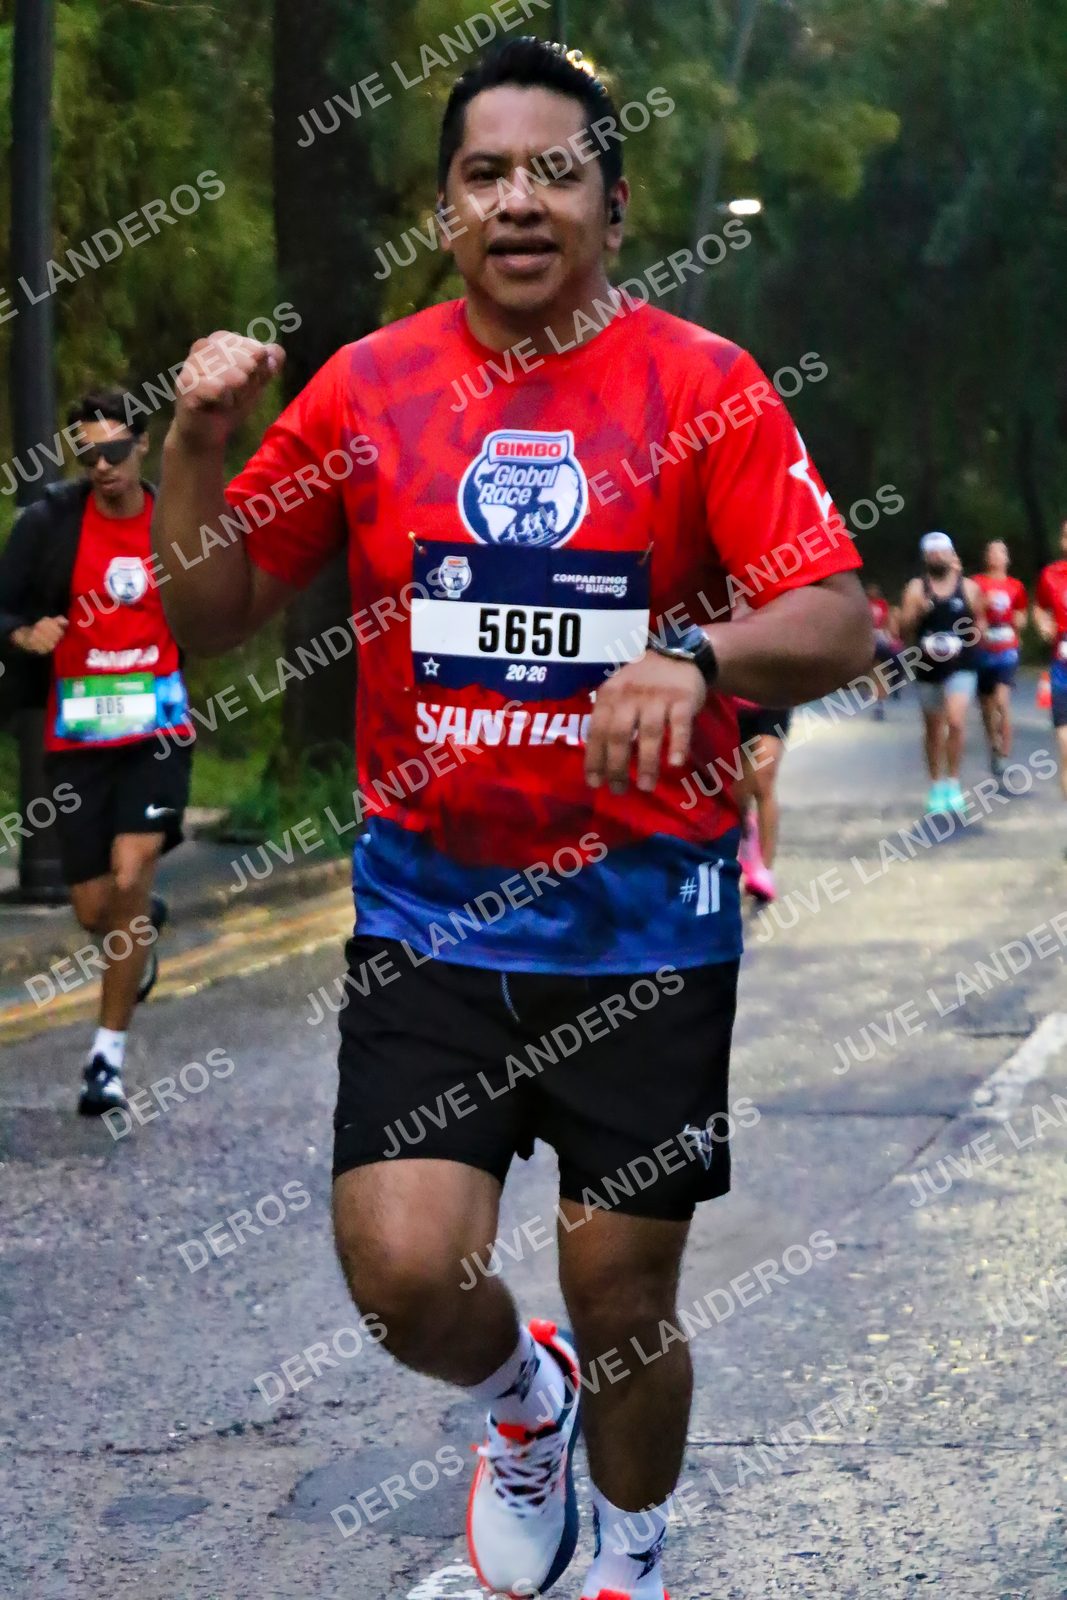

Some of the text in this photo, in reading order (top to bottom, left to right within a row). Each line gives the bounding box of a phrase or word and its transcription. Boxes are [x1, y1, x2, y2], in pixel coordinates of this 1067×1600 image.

[496, 442, 561, 457] BIMBO
[493, 465, 558, 487] Global
[478, 483, 532, 505] Race
[553, 573, 628, 584] COMPARTIMOS
[479, 607, 581, 657] 5650
